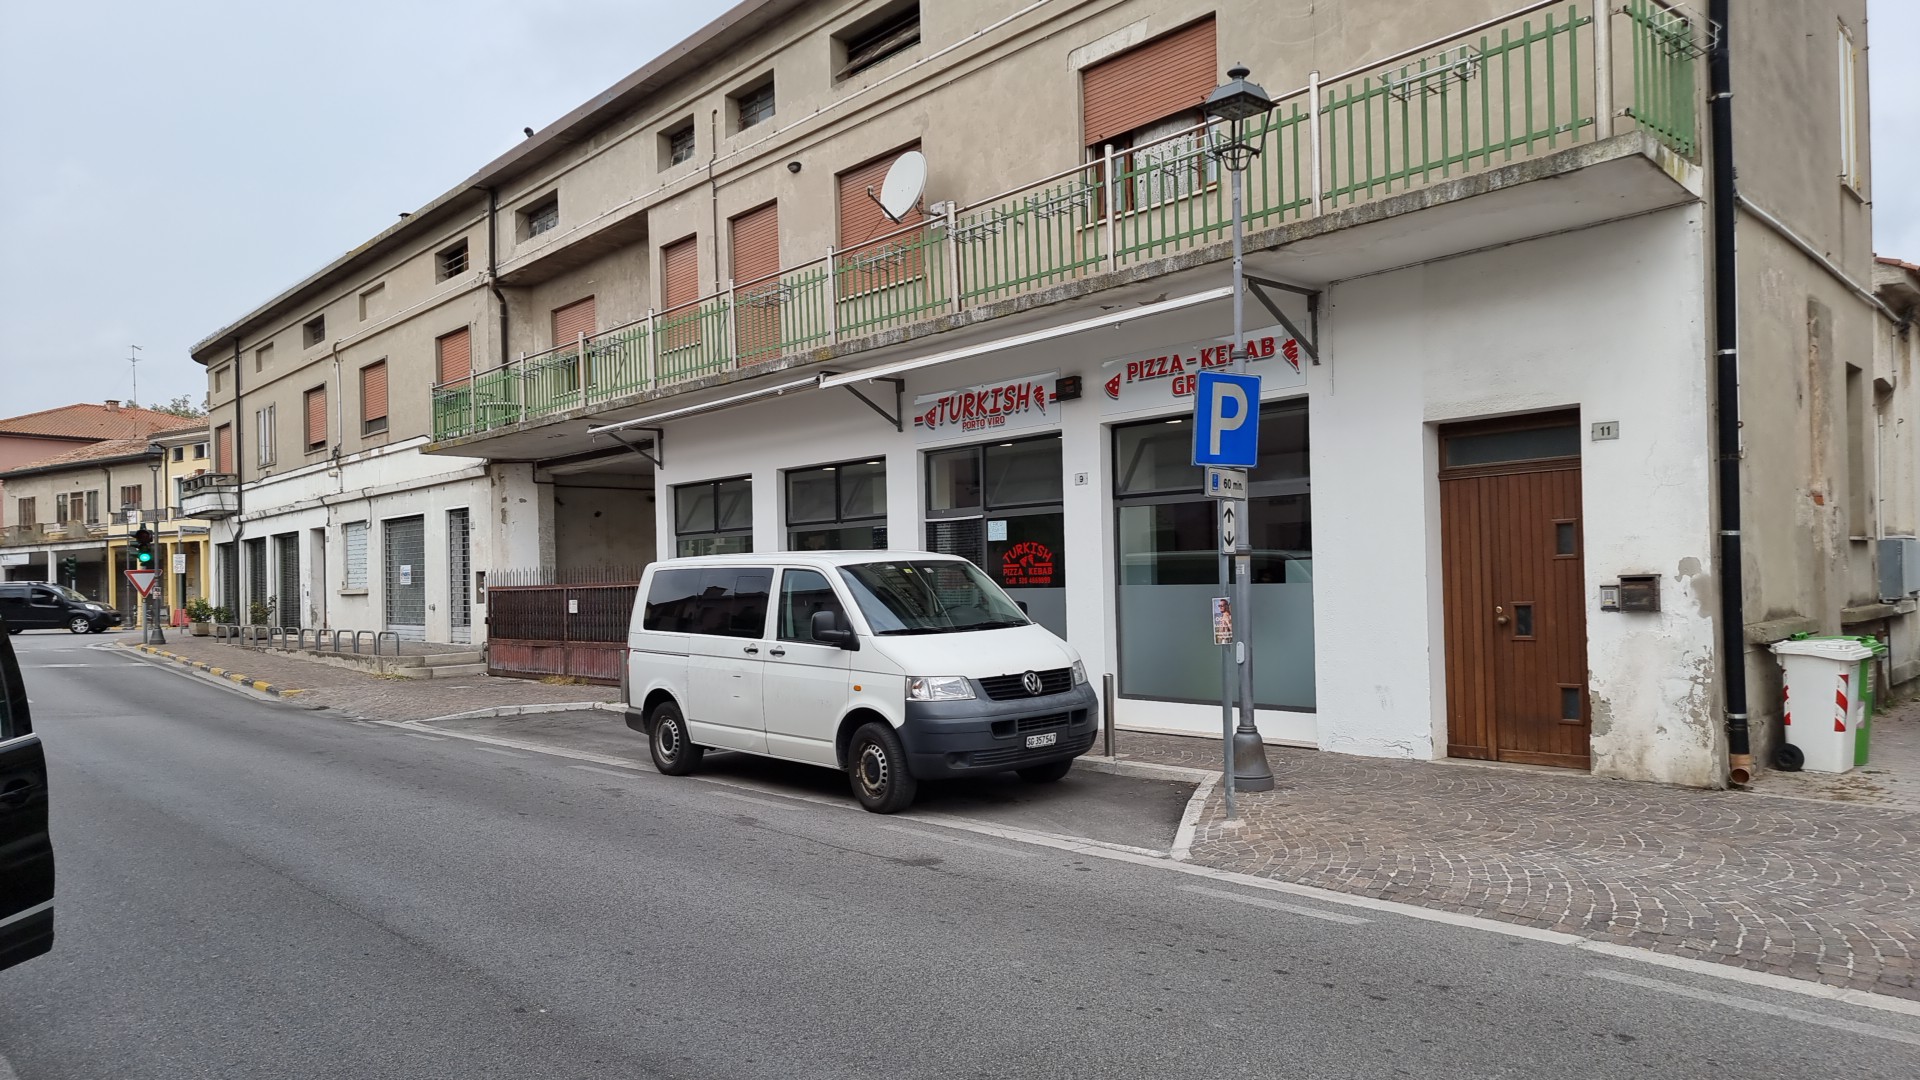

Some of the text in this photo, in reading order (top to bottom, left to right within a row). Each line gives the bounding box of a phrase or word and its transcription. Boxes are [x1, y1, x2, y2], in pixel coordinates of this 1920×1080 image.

[1126, 354, 1184, 382] PIZZA
[938, 382, 1031, 423] TURKISH
[962, 415, 1006, 431] PORTO VIRO
[1209, 381, 1248, 456] P
[1600, 426, 1611, 436] 11
[1223, 478, 1231, 490] 60
[1003, 542, 1052, 563] TURKISH
[1003, 567, 1052, 576] PIZZA KEBAB
